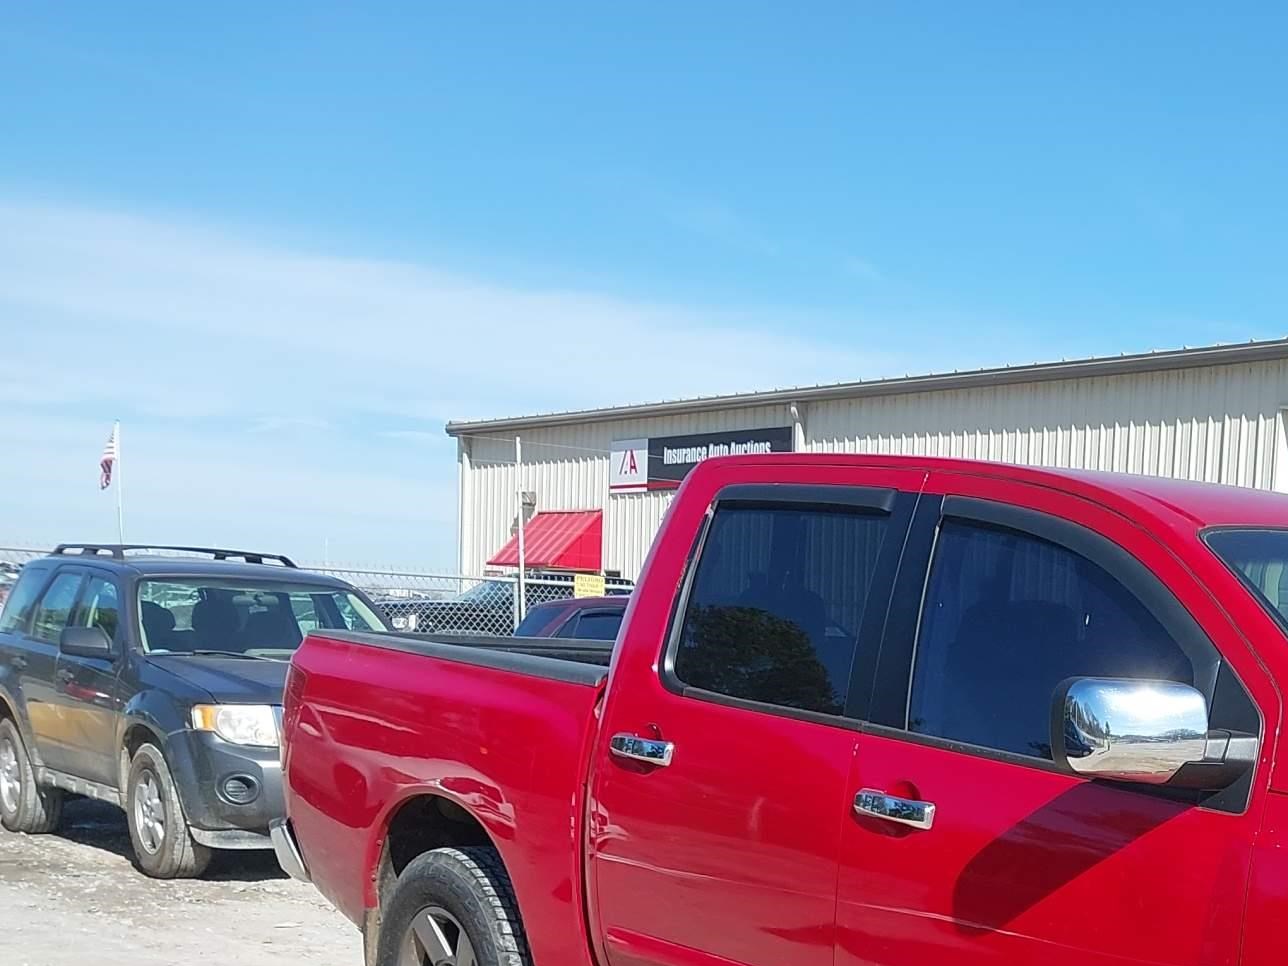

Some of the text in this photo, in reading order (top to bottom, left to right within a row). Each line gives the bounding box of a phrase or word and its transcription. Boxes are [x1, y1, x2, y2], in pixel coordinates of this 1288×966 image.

[663, 440, 772, 464] Insurance Auto Auctions
